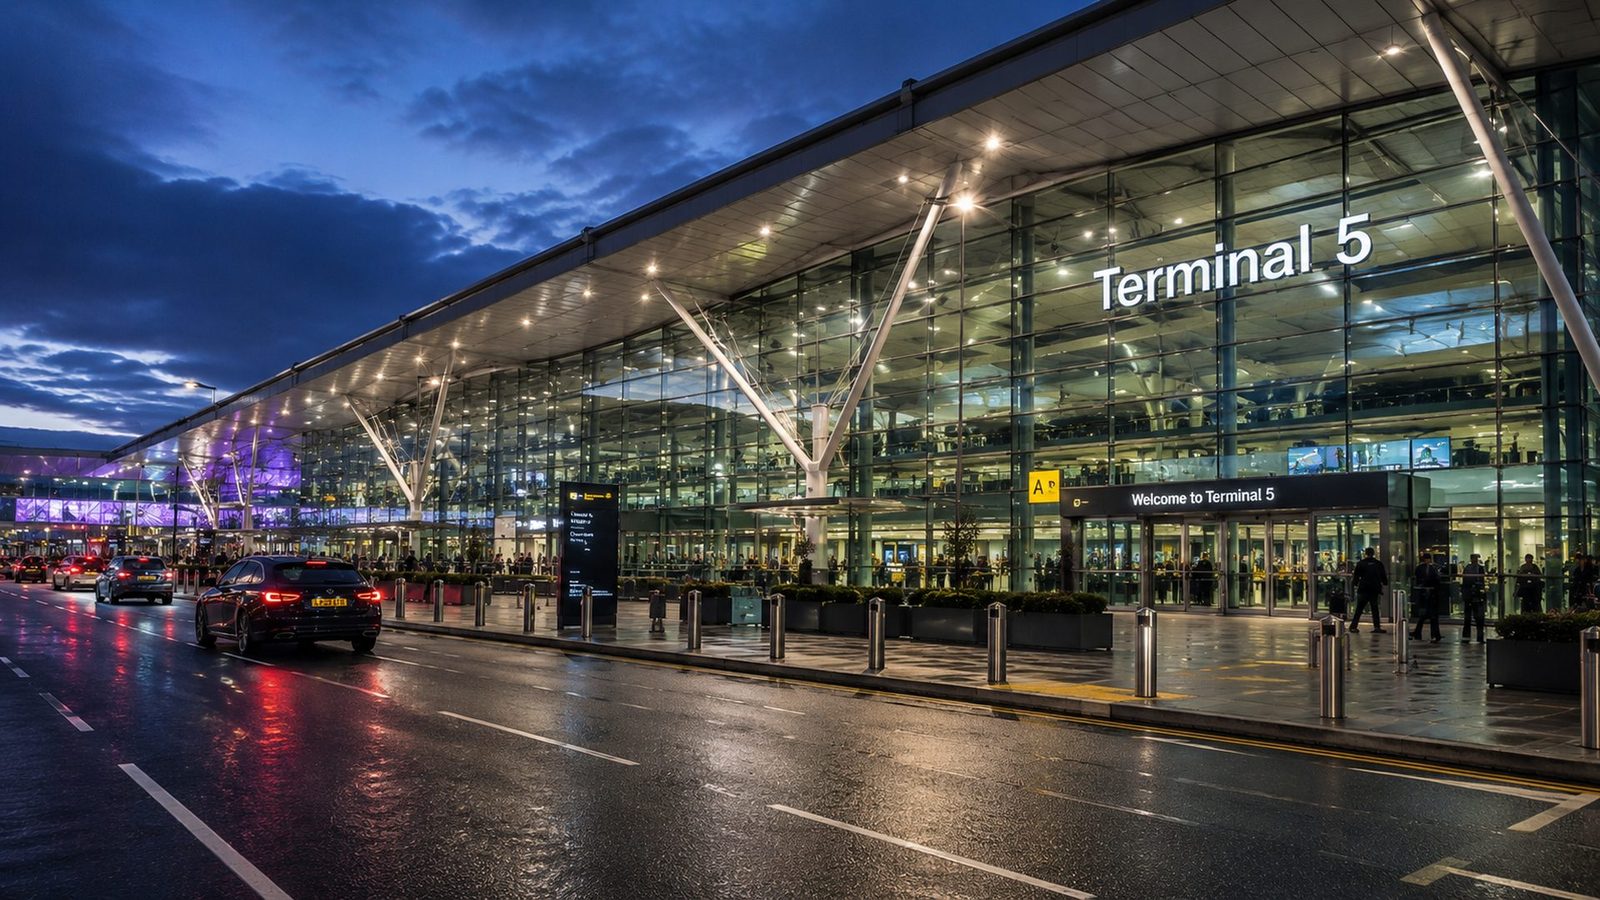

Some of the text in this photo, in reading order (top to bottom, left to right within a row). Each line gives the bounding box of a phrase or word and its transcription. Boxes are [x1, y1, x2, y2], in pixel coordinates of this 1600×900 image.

[1093, 213, 1372, 310] Terminal 5
[1033, 479, 1044, 495] A
[1131, 487, 1275, 506] Welcome to Terminal 5
